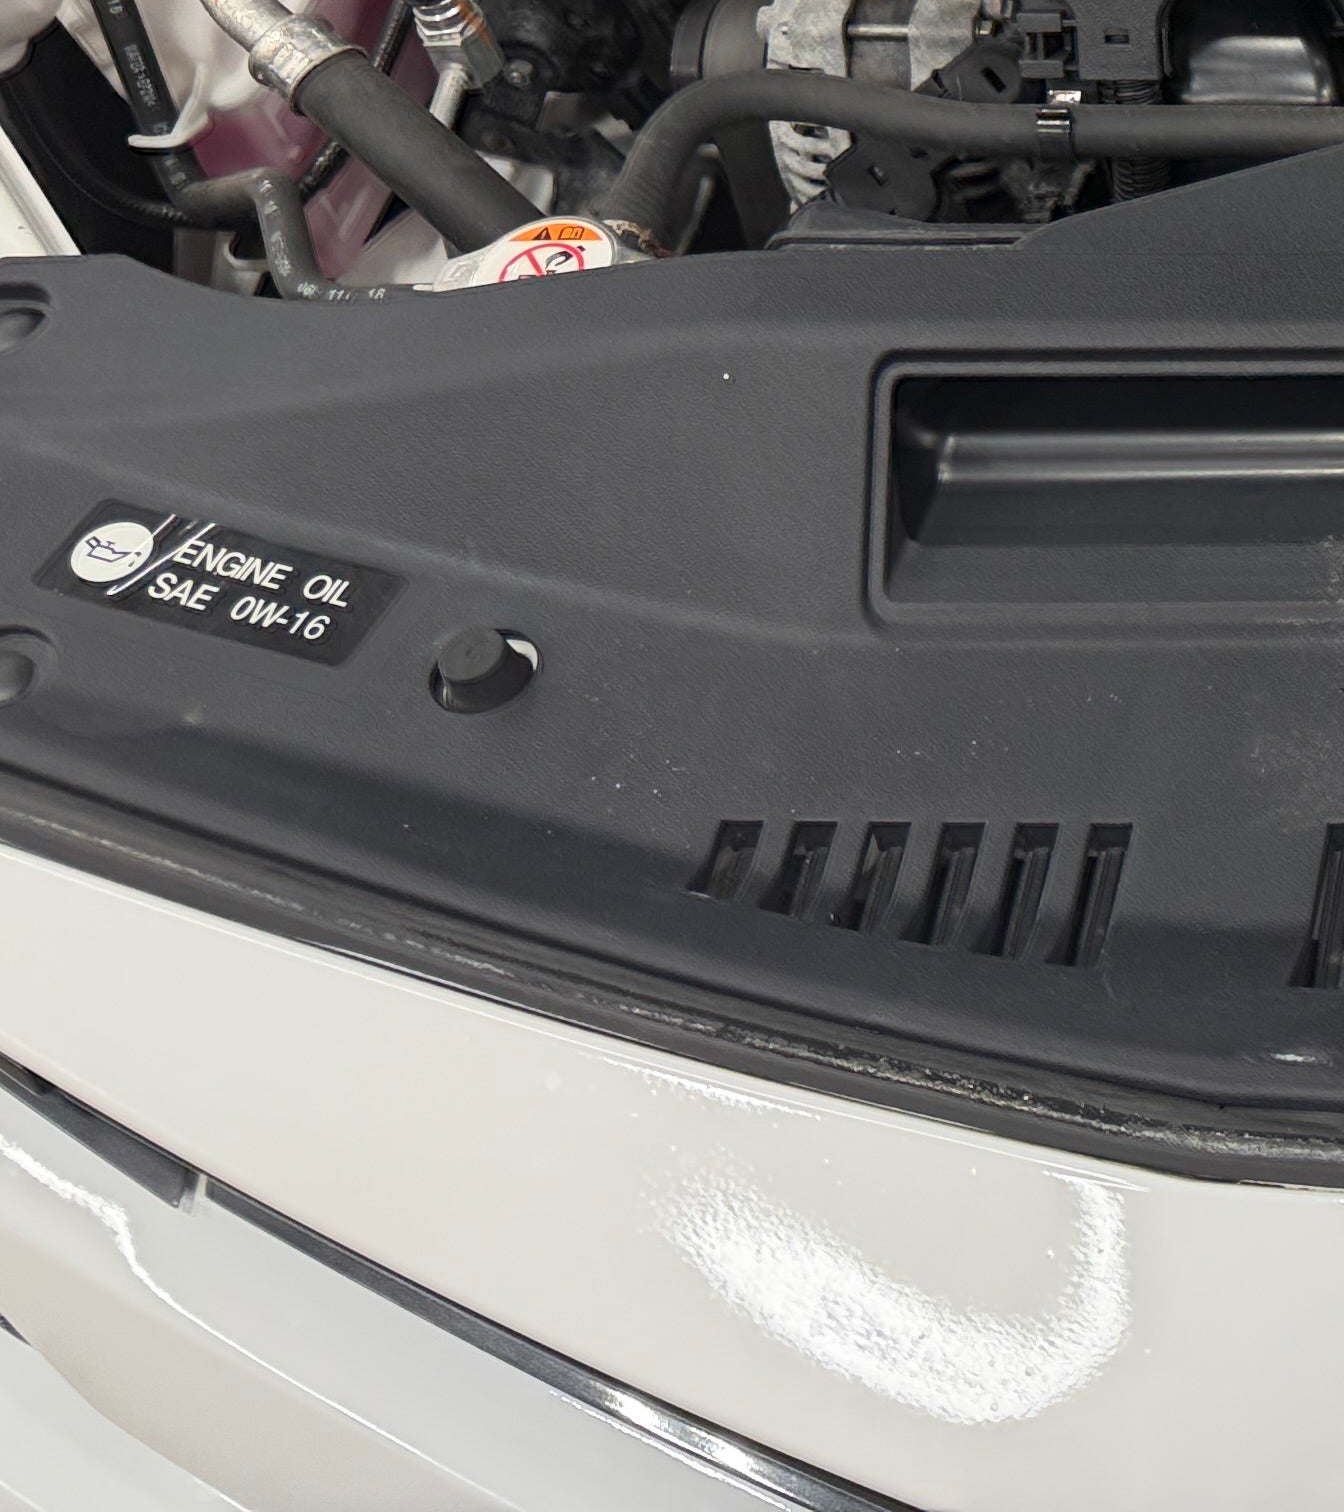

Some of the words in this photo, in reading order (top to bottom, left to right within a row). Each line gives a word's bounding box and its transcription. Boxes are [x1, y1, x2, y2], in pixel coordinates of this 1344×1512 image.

[147, 572, 220, 612] SAE
[229, 595, 330, 641] 0W-16
[172, 539, 293, 590] ENGINE
[302, 573, 351, 608] OIL
